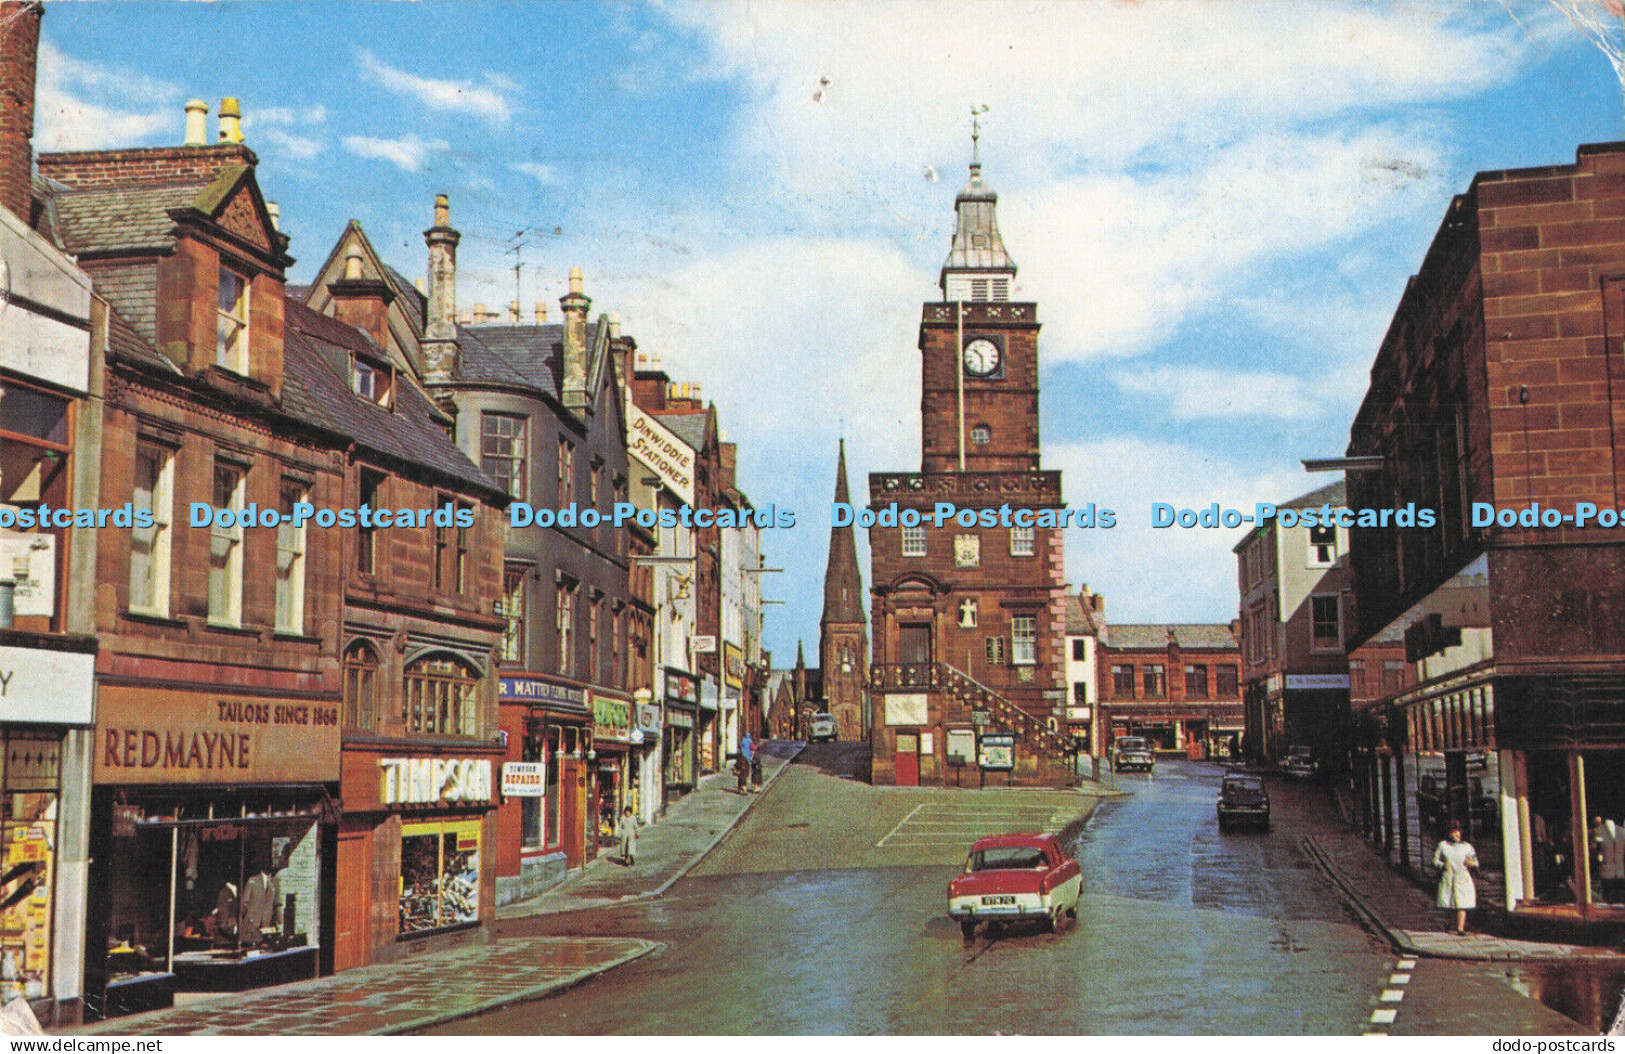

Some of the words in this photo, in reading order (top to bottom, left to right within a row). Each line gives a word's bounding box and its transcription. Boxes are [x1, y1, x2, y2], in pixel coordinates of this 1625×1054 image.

[632, 438, 690, 488] STATIONER
[633, 417, 690, 468] DINWIDDIE
[218, 701, 270, 724] TAILORS
[274, 705, 309, 725] SINCE
[103, 728, 250, 770] REDMAYNE
[377, 757, 492, 804] TIMPSON
[505, 774, 541, 785] REPAIRS
